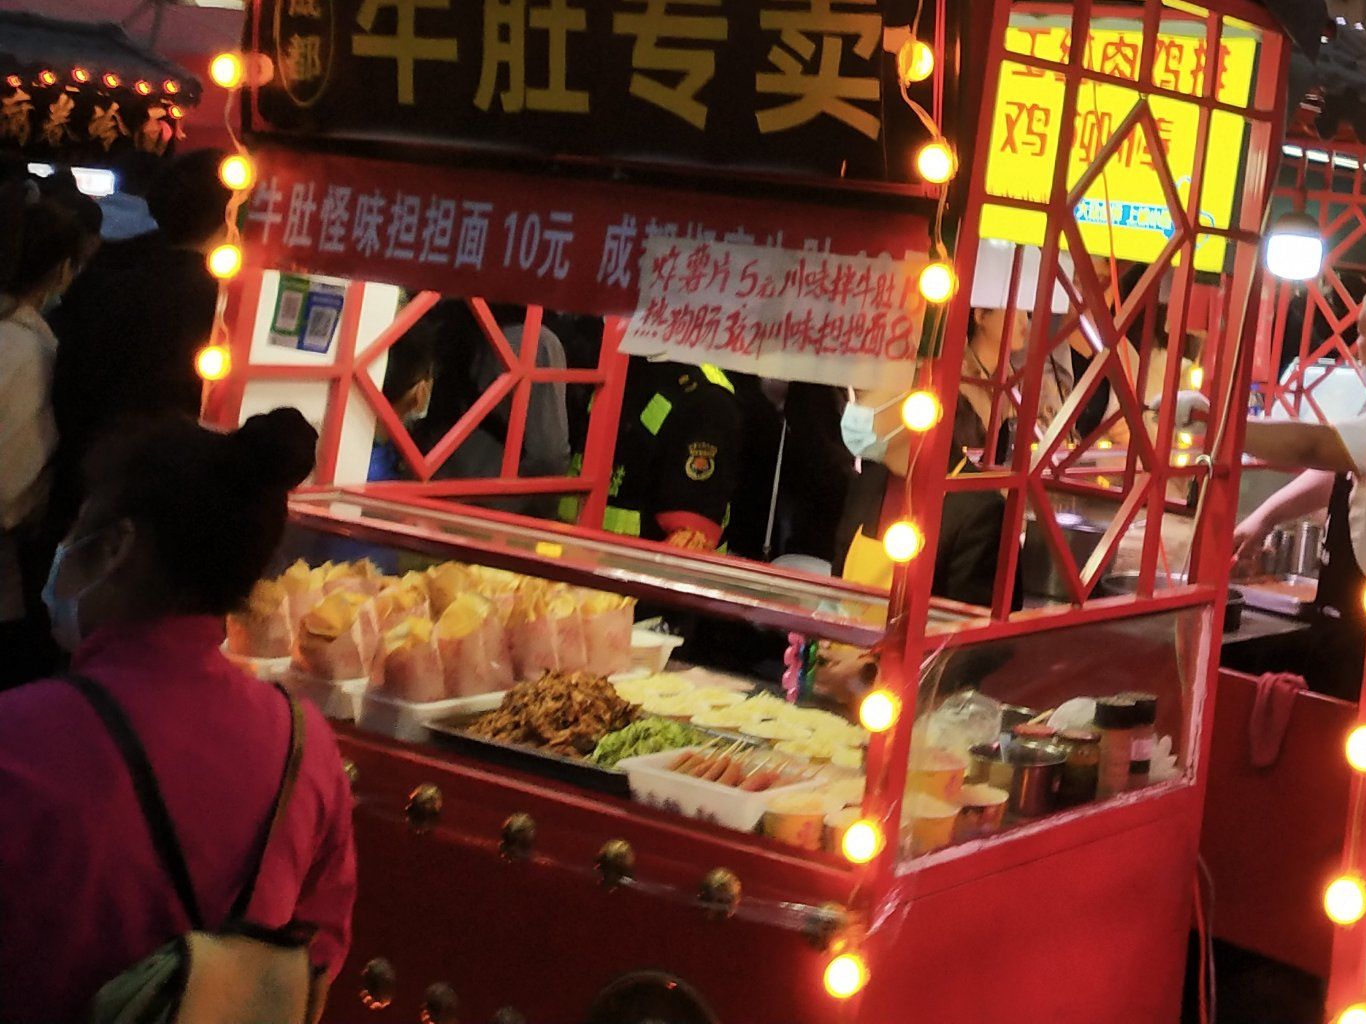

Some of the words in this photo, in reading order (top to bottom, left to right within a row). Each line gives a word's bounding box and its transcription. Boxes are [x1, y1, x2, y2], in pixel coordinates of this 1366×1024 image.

[248, 177, 493, 271] 牛肚怪味担担面
[503, 211, 575, 281] 10元
